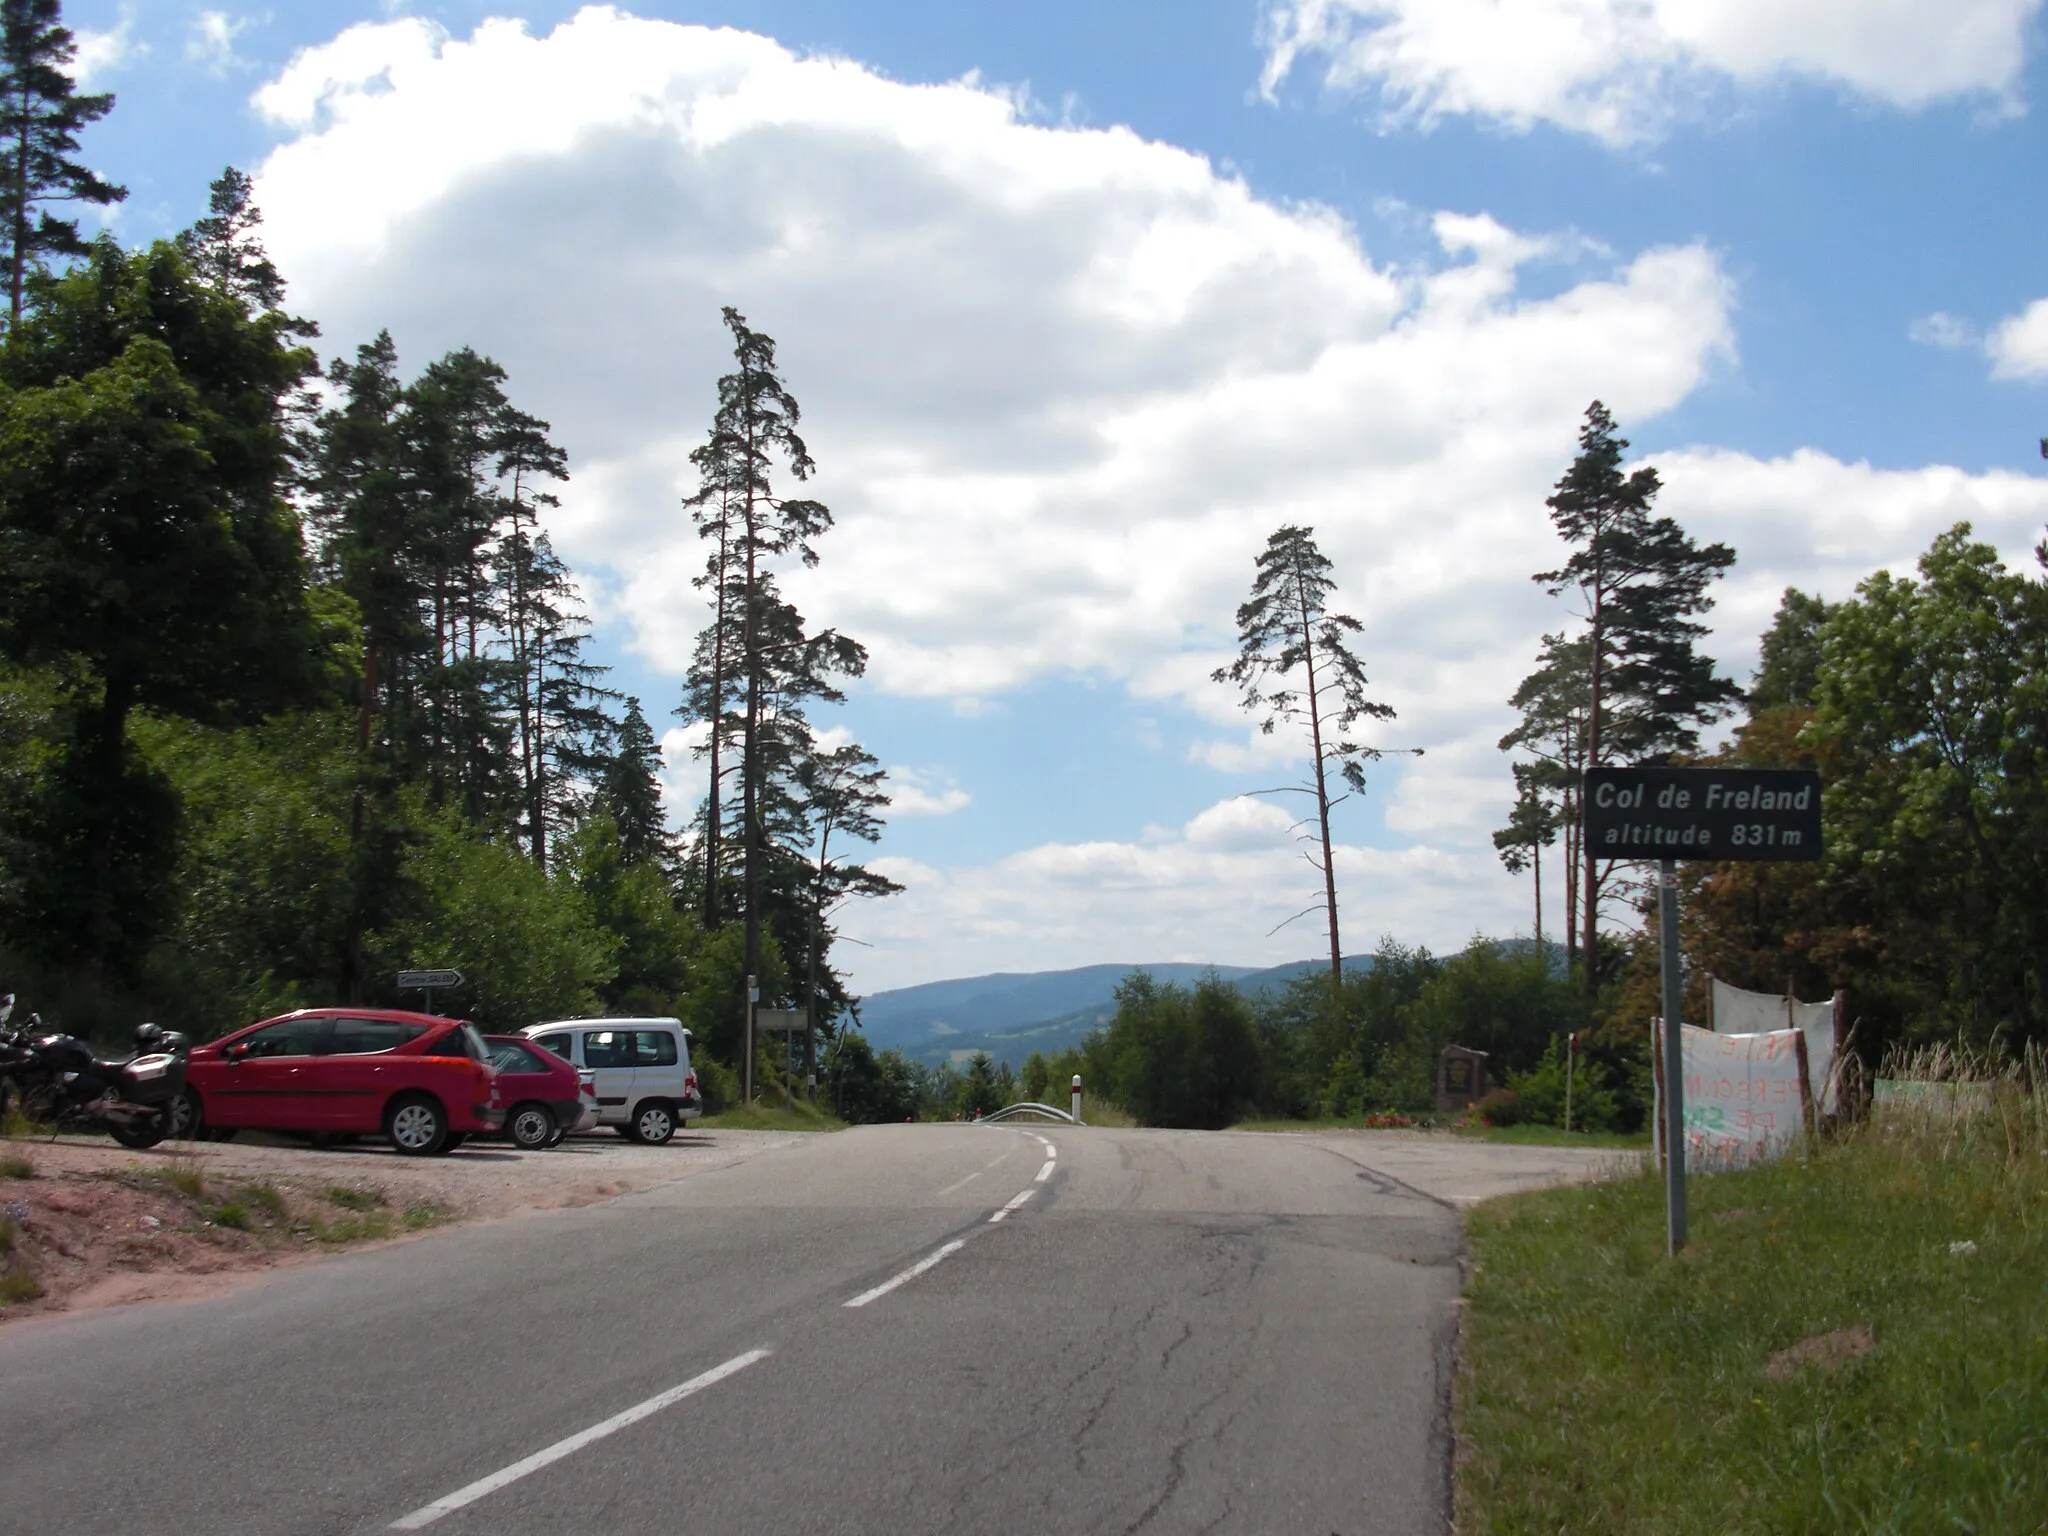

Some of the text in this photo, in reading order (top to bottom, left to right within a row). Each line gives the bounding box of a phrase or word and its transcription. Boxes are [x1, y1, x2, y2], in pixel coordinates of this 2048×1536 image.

[1595, 782, 1811, 810] Col de Freland
[1605, 824, 1711, 845] altitude
